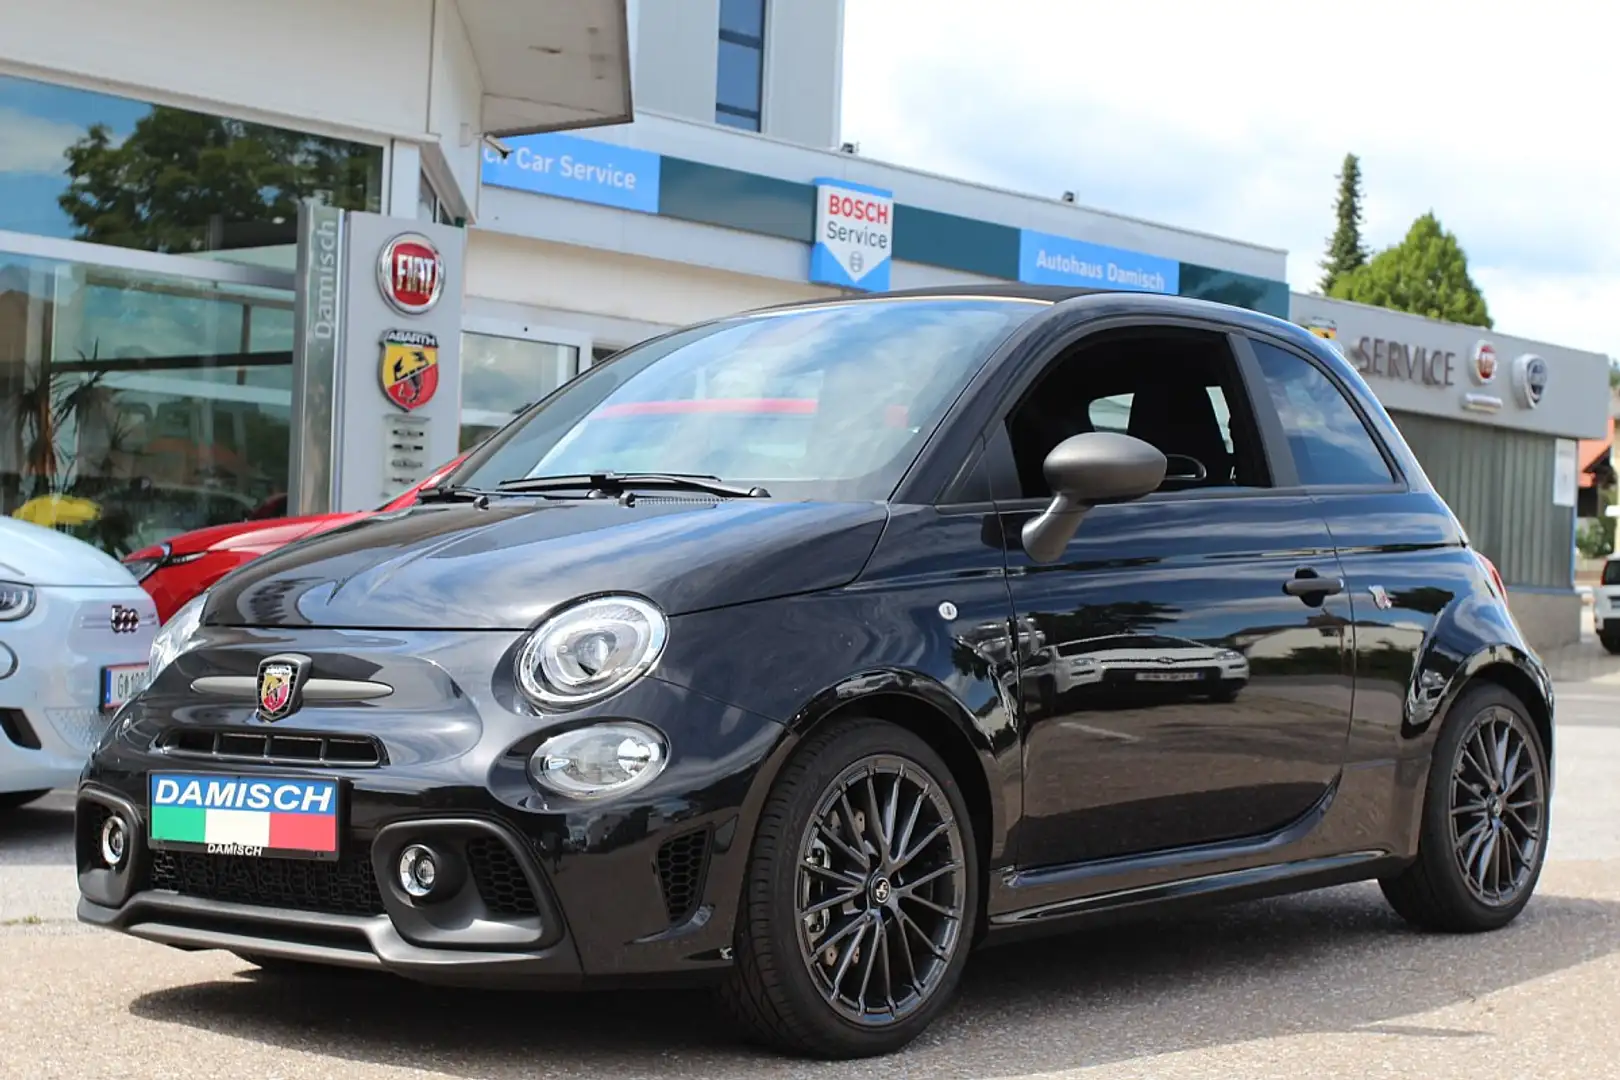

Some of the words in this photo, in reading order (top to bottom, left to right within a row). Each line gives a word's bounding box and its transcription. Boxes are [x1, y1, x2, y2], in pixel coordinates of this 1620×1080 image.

[516, 147, 554, 173] Car
[560, 155, 637, 190] Service
[828, 194, 889, 224] BOSCH
[826, 220, 888, 249] Service
[314, 221, 337, 339] Damisch
[397, 253, 434, 294] FIAT
[1036, 249, 1103, 278] Autohaus
[1107, 262, 1165, 291] Damisch
[1359, 336, 1456, 386] SERVICE
[155, 779, 333, 812] DAMISCH
[207, 843, 263, 857] DAMISCH
